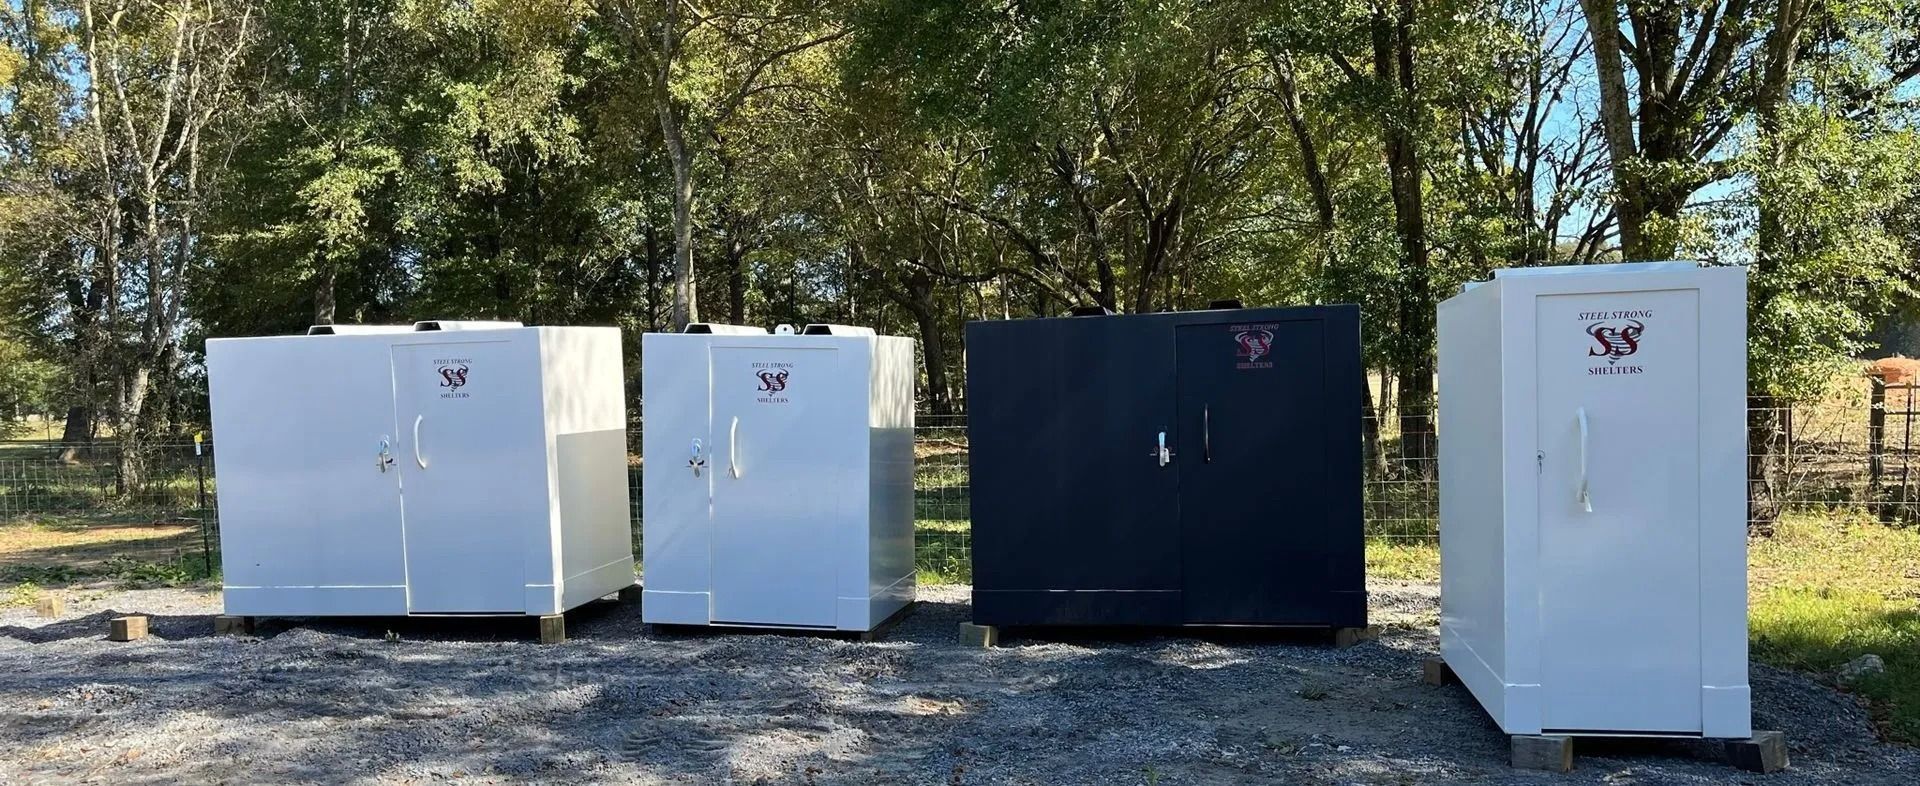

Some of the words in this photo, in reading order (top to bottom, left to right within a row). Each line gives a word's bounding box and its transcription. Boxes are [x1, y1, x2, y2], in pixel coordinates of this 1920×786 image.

[1577, 312, 1609, 320] STEEL
[1611, 310, 1652, 319] STRONG
[1588, 366, 1643, 375] SHELTERS
